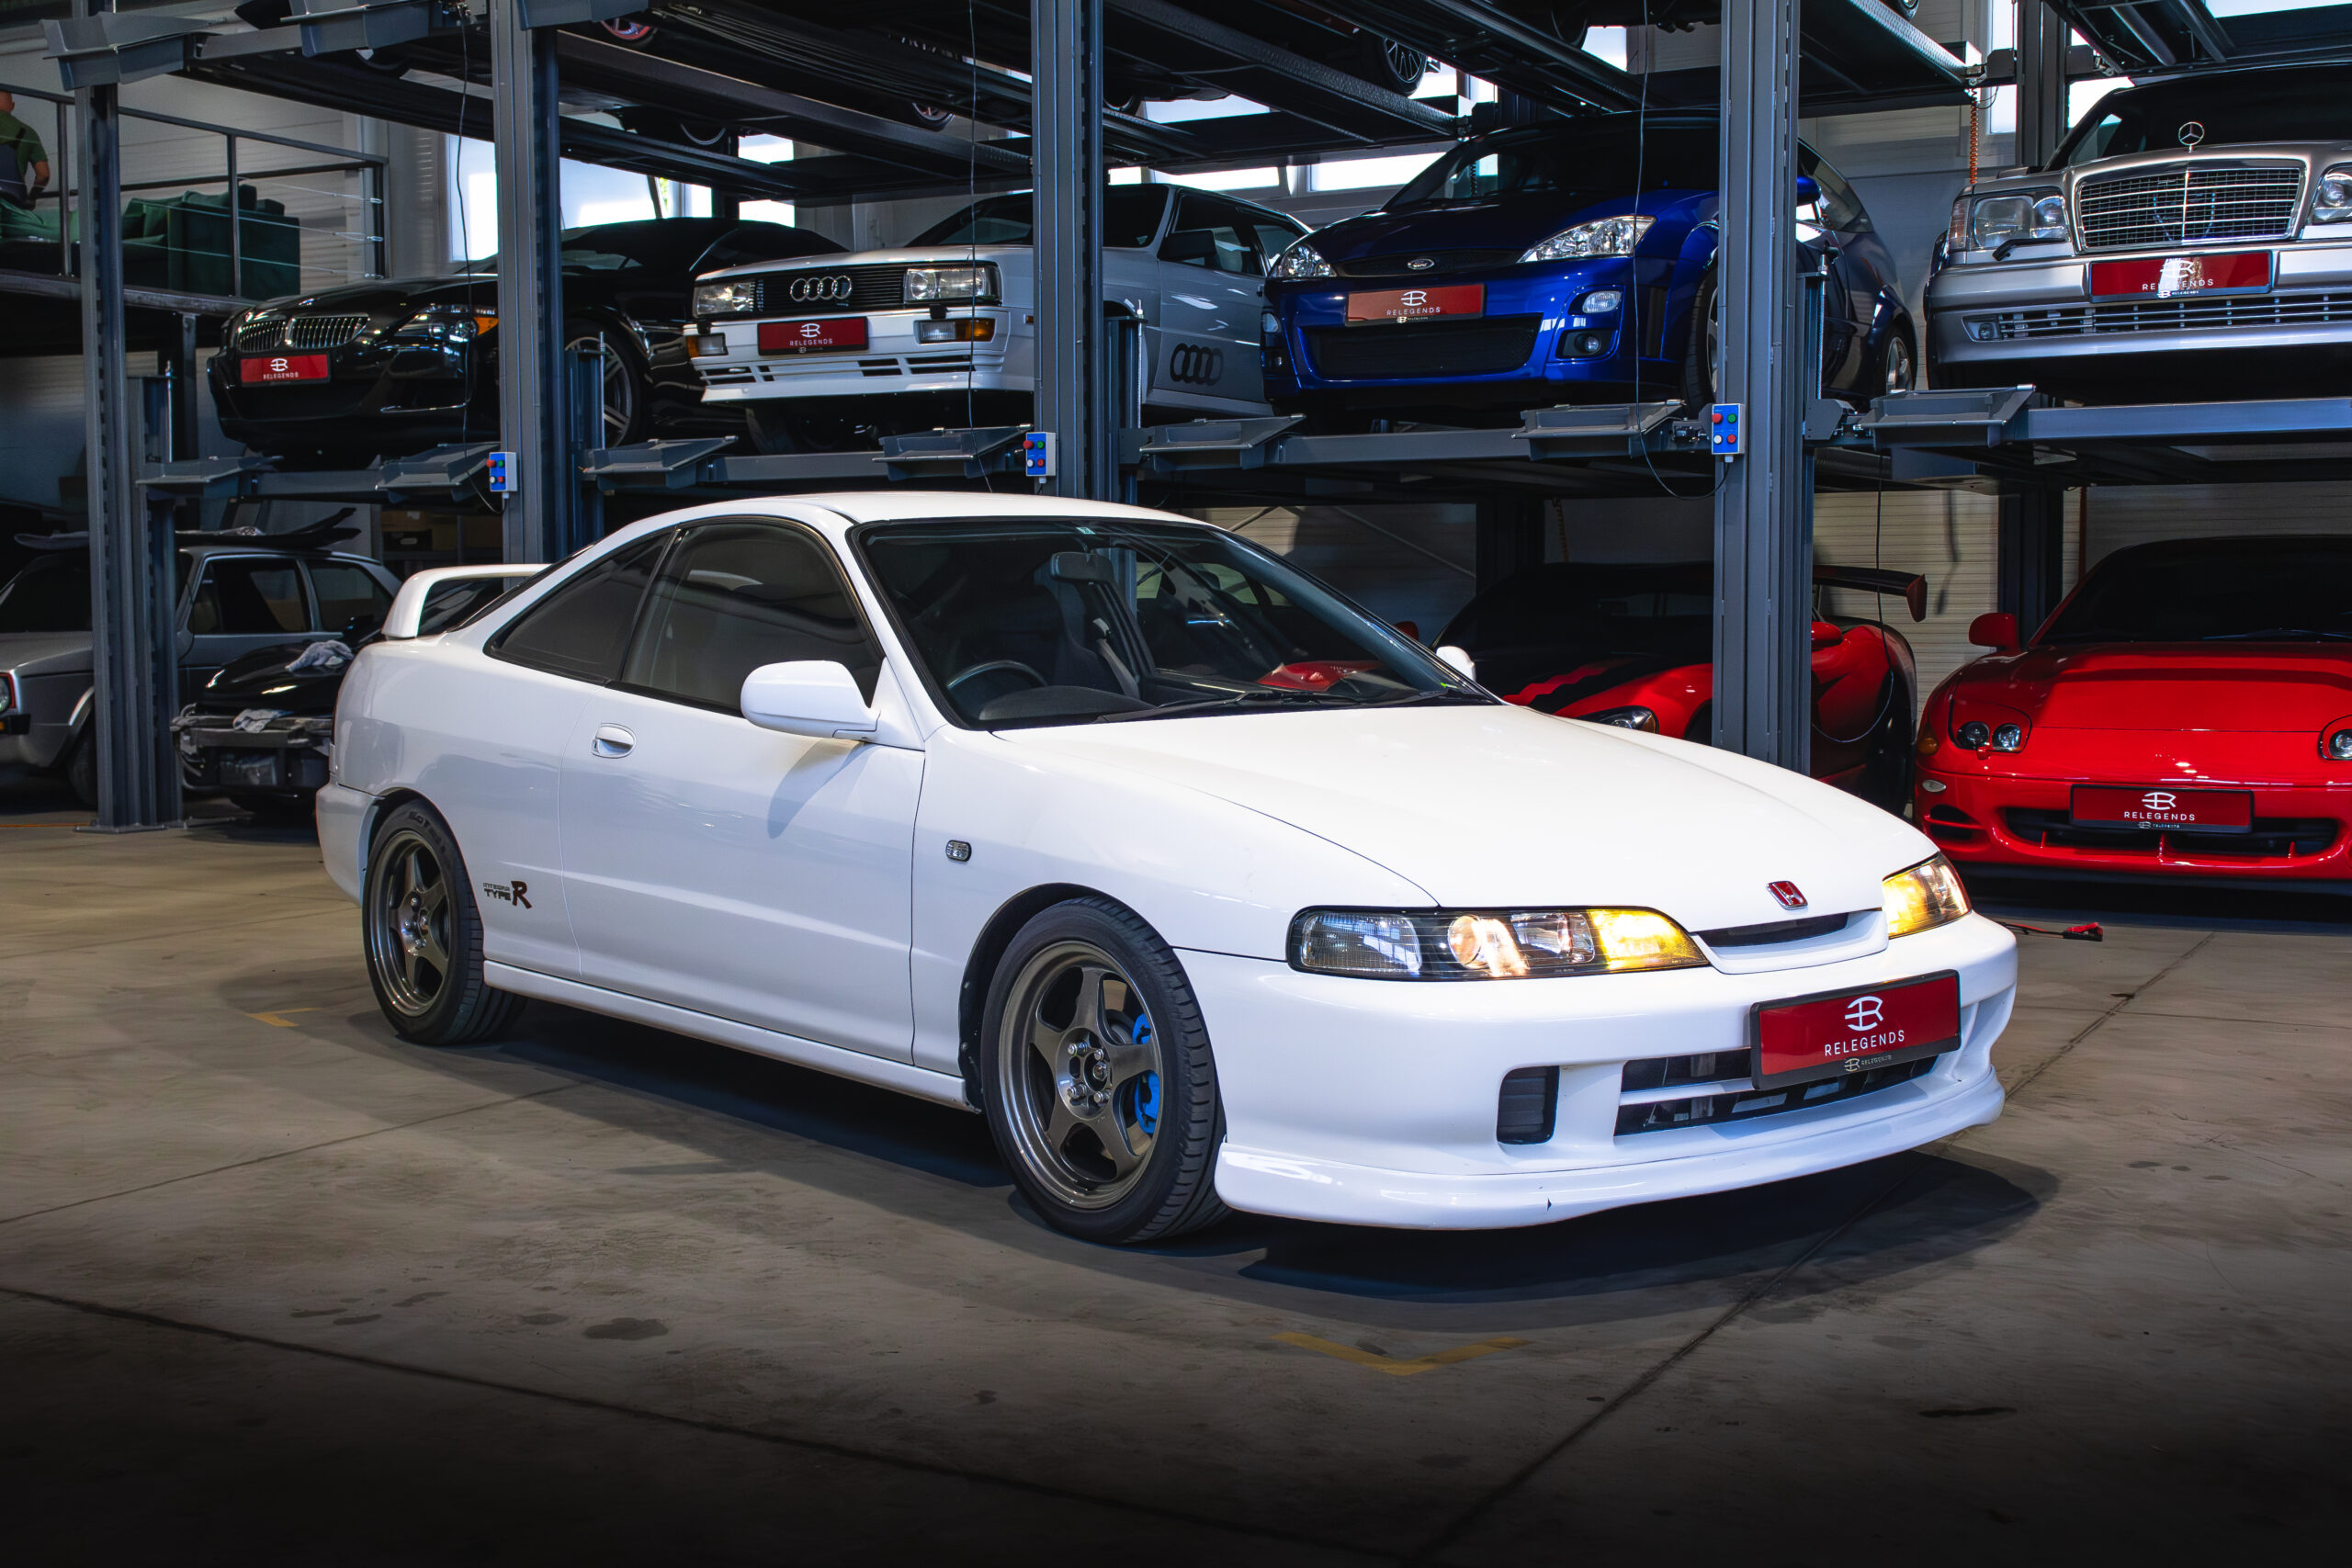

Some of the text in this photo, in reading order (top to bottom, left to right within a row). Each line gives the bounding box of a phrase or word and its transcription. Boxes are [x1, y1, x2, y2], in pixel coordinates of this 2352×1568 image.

[2142, 278, 2213, 290] REENDS
[1386, 306, 1441, 316] RELEGENDS
[789, 338, 833, 346] RELEGENDS
[2123, 811, 2195, 821] RELEGENDS
[484, 880, 532, 909] TYPE R
[1825, 1030, 1905, 1056] RELEGENDS
